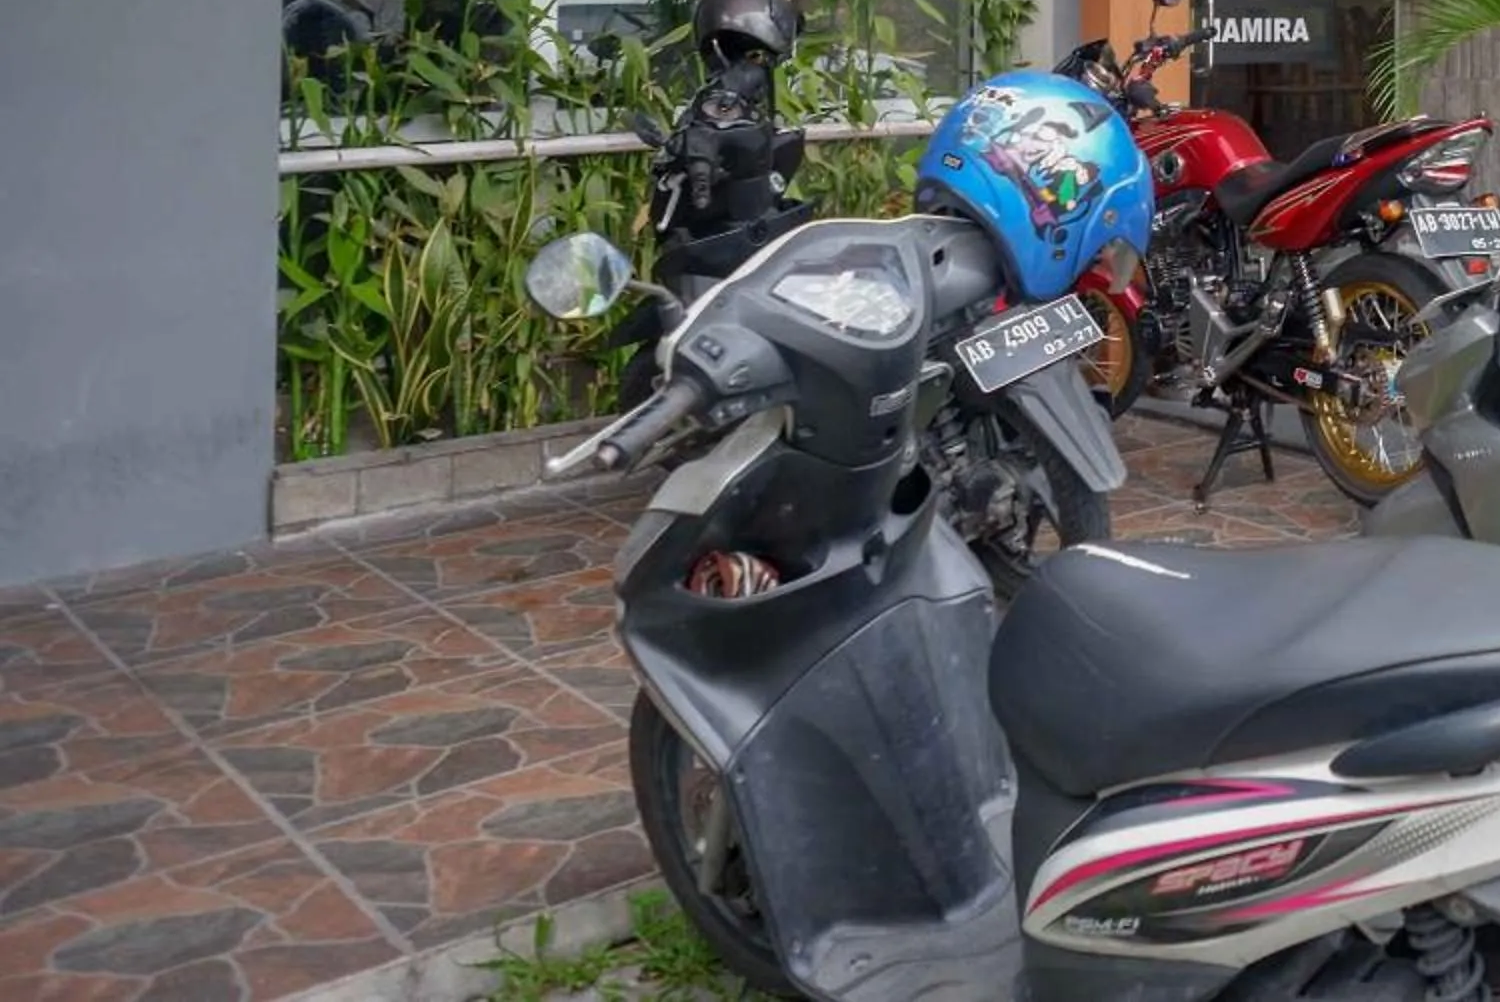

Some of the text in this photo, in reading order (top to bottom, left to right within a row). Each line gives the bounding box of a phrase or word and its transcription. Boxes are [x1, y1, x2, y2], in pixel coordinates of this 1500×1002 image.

[1417, 213, 1439, 234] AB
[965, 303, 1084, 366] AB 4909 VL
